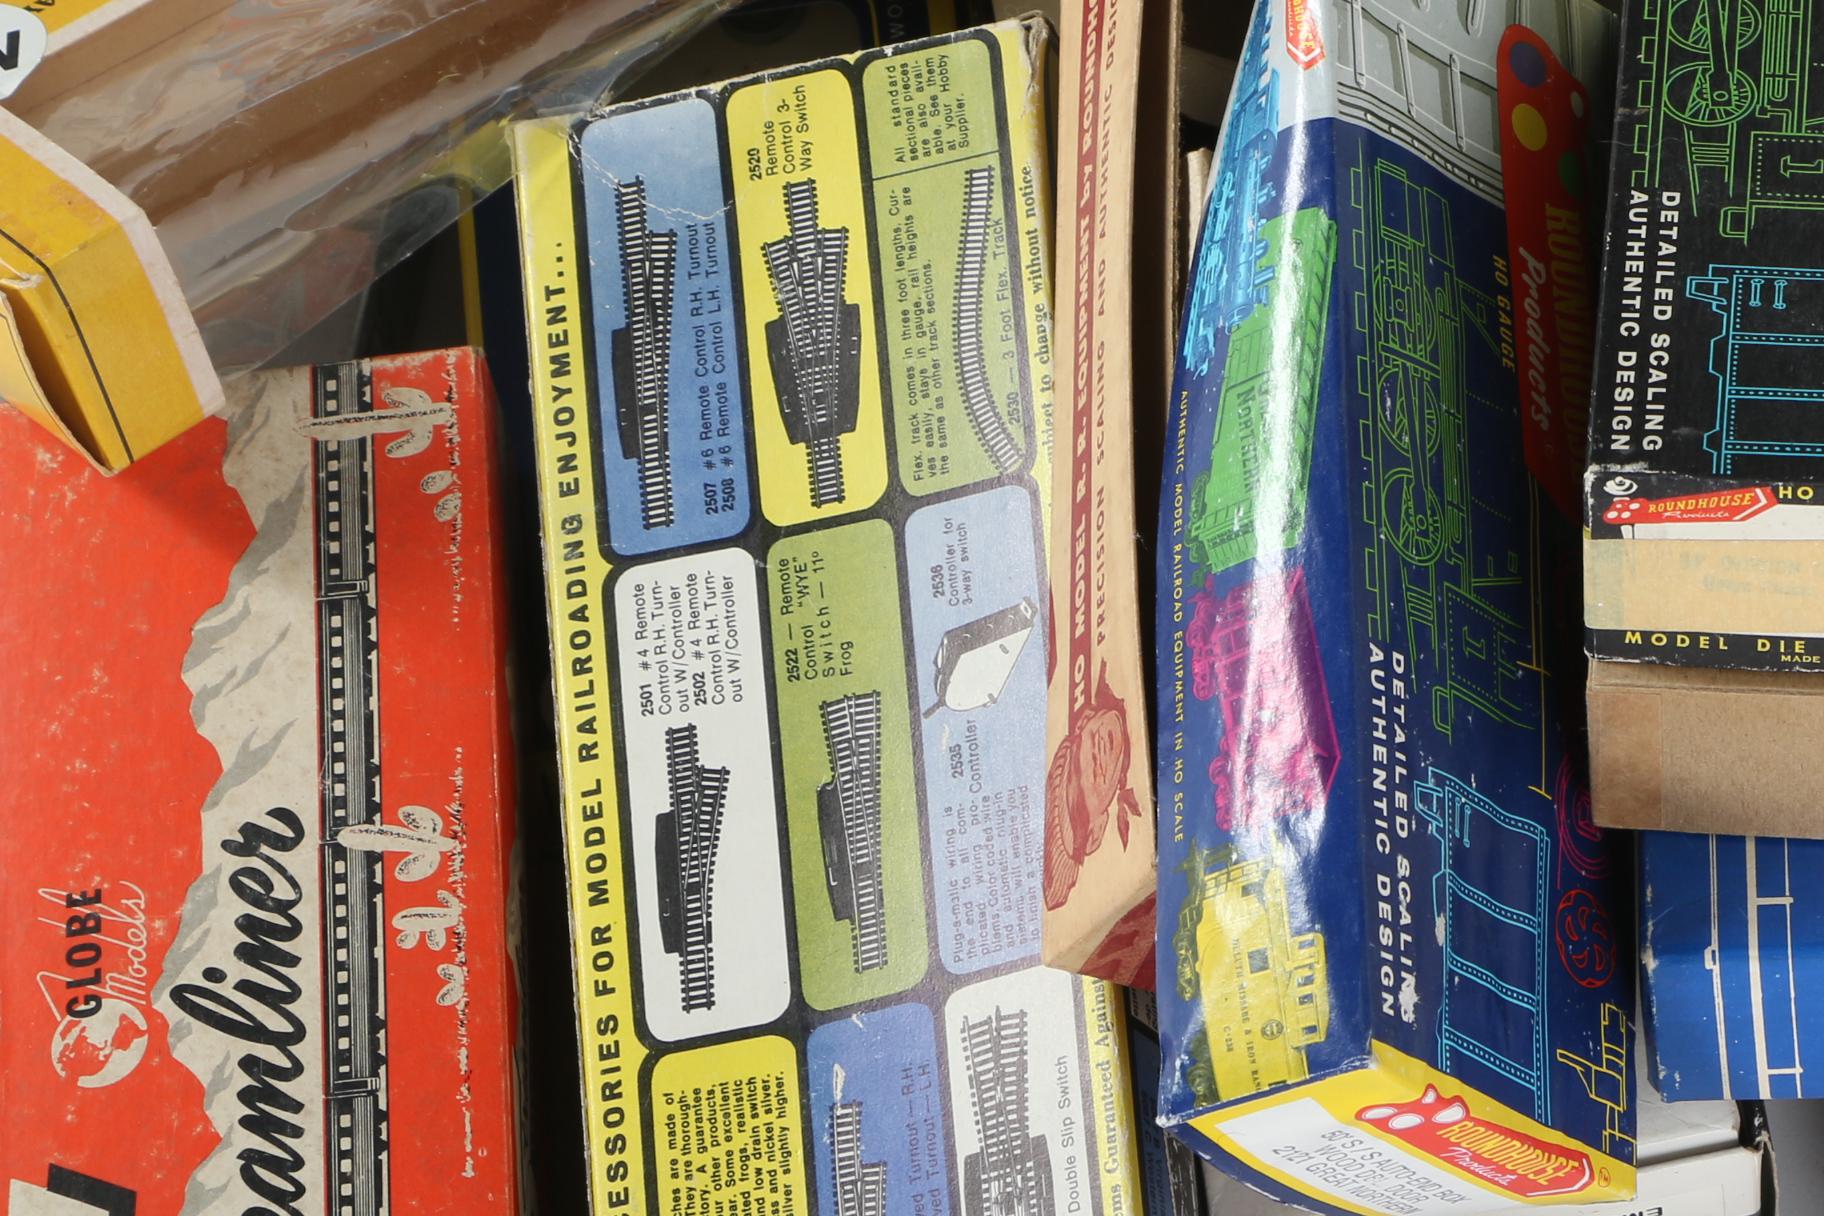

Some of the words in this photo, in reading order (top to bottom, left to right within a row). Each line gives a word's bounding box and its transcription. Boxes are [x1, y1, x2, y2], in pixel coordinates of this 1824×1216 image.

[776, 98, 790, 112] 3-
[792, 84, 809, 133] Switch
[746, 147, 762, 180] 2520
[762, 120, 778, 176] Remote
[778, 120, 795, 174] Control
[799, 140, 813, 171] Way
[685, 222, 701, 280] Turnout
[1619, 189, 1648, 336] AUTHENTIC
[1653, 191, 1680, 320] DETAILED
[689, 287, 703, 317] R.H.
[546, 241, 581, 497] ENJOYMENT...
[691, 324, 708, 377] Control
[697, 385, 712, 440] Remote
[1610, 351, 1637, 450] DESIGN
[1641, 333, 1670, 450] SCALING
[703, 482, 718, 514] 2507
[1648, 490, 1755, 514] ROUNDHOUSE
[1779, 487, 1814, 499] HO
[561, 513, 599, 762] RAILROADING
[1625, 632, 1730, 651] MODEL
[1757, 638, 1806, 654] DIE
[1368, 642, 1389, 854] AUTHENTIC
[1392, 651, 1407, 838] DETAILED
[581, 778, 609, 906] MODEL
[65, 887, 102, 1019] GLOBE
[591, 923, 616, 996] FOR
[1376, 873, 1393, 1016] DESIGN
[169, 807, 306, 1216] amliner
